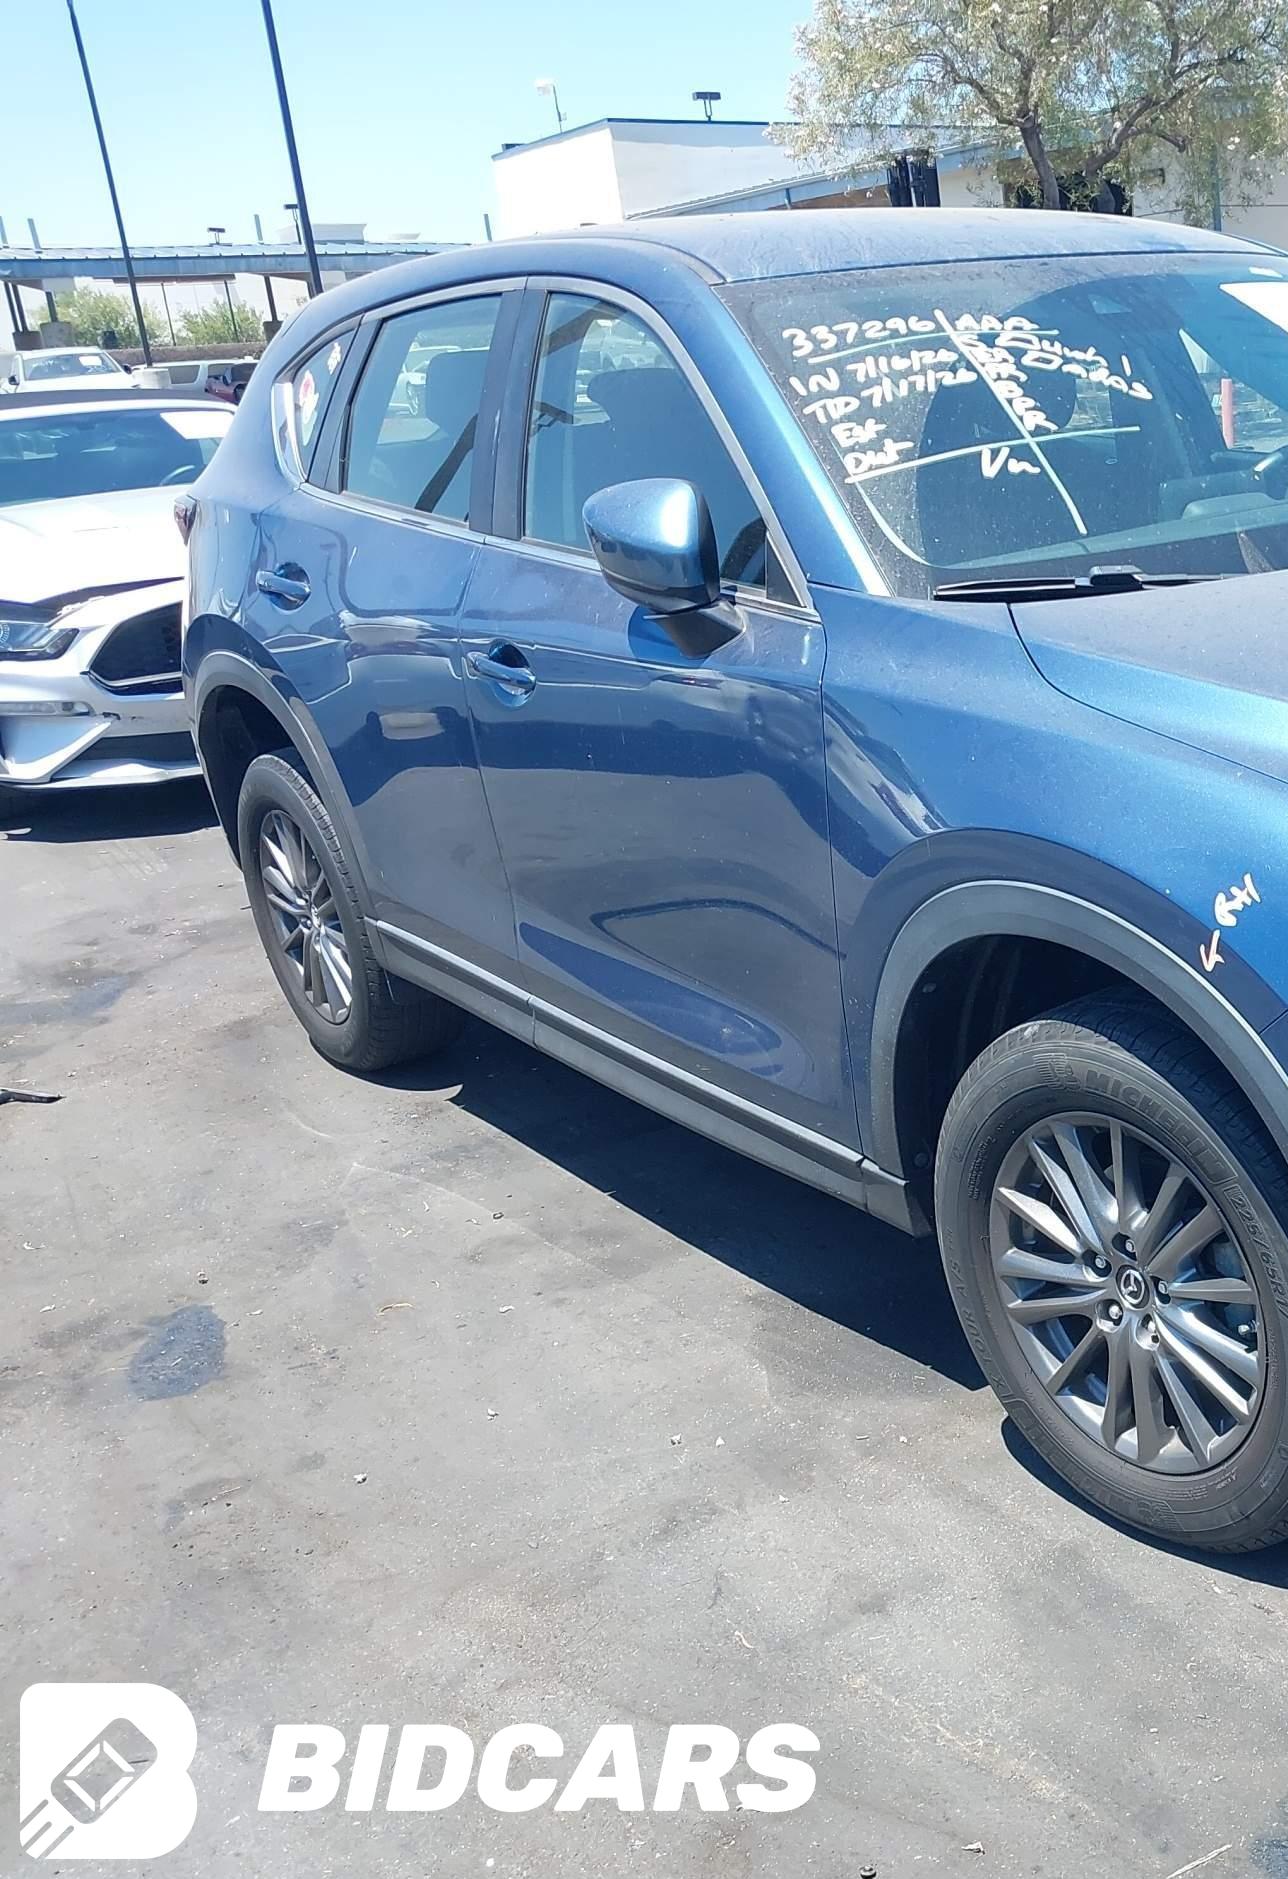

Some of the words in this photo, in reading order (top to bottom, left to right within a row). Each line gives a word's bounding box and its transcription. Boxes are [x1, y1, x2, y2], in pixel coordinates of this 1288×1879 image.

[782, 316, 935, 357] 337296
[789, 367, 840, 396] IN
[1085, 1069, 1228, 1182] MICHELIN
